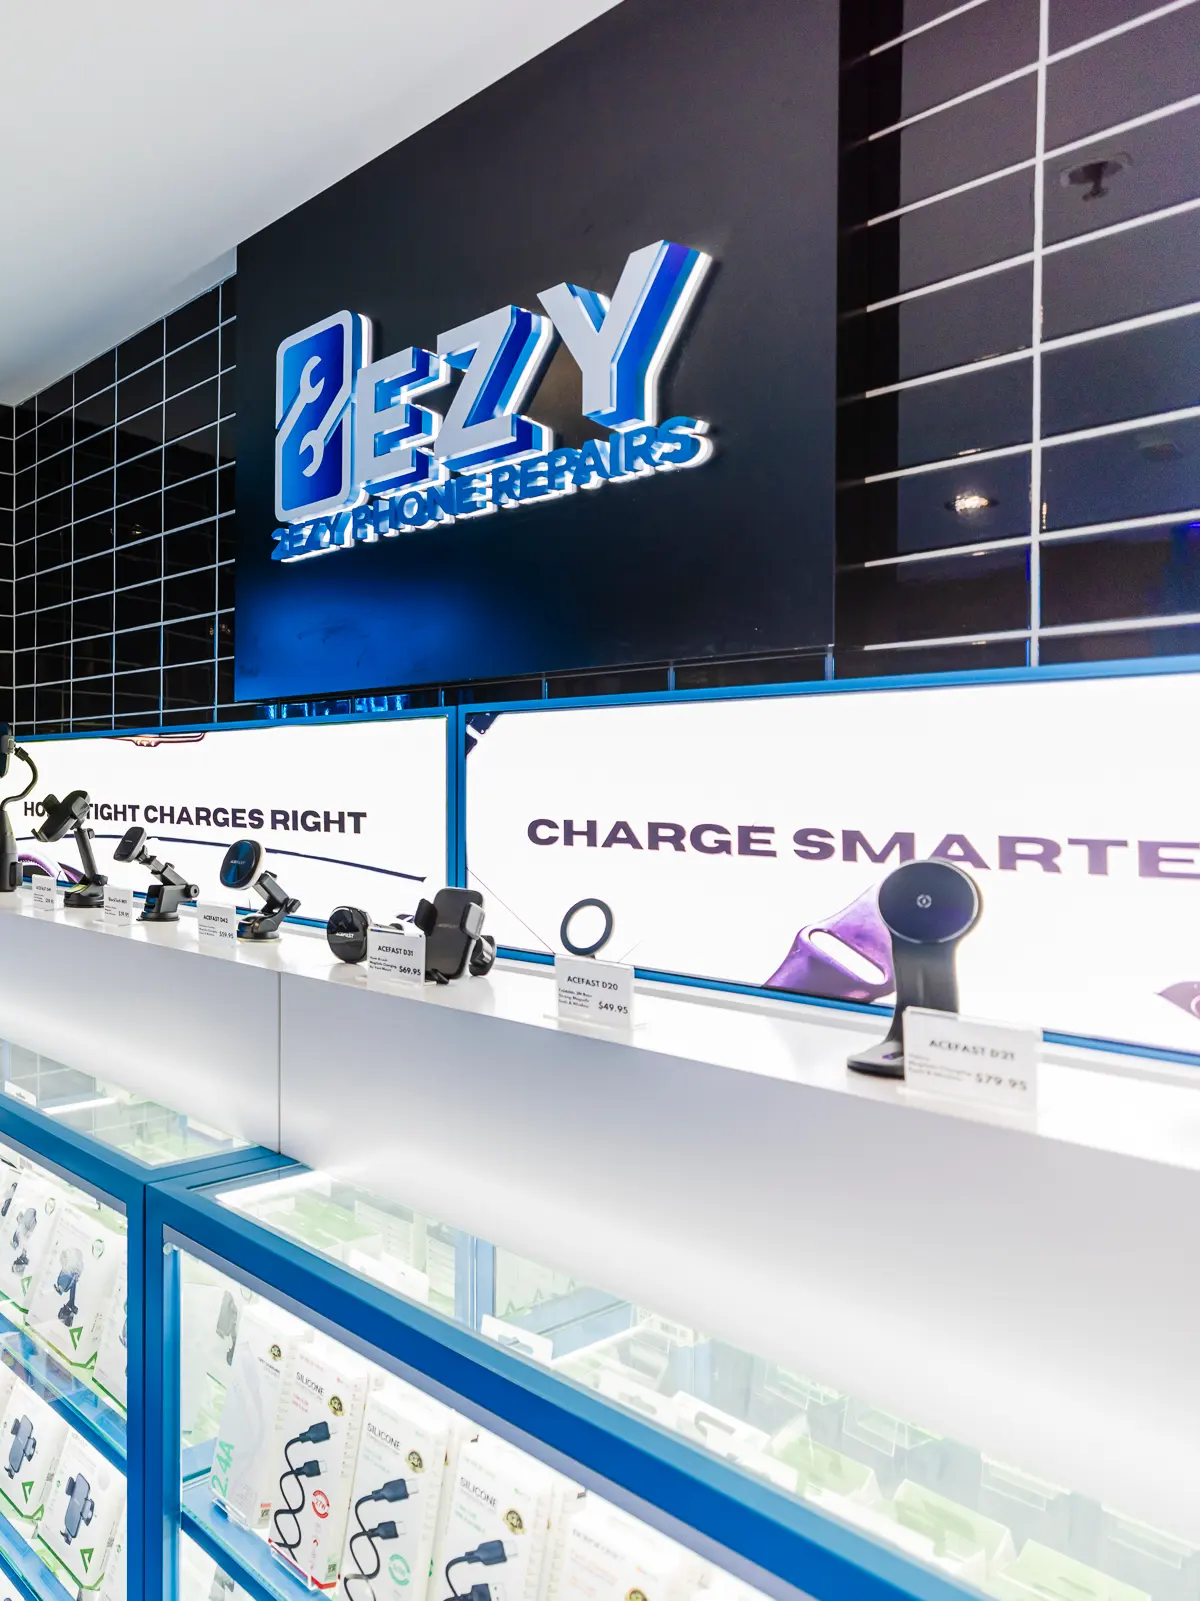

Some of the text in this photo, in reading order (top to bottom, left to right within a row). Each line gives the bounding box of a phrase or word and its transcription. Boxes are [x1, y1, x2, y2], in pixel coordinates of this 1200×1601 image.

[352, 474, 496, 542] PHONE
[492, 416, 713, 508] REPAIRS
[144, 804, 265, 830] CHARGES
[270, 808, 367, 835] RIGHT
[526, 817, 777, 858] CHARGE
[378, 945, 402, 955] ACEFAST
[399, 965, 422, 977] $69.95
[567, 975, 619, 991] ACEFAST D20
[598, 1000, 629, 1014] $49.95
[928, 1039, 1015, 1061] ACEFAST D21
[295, 1371, 325, 1397] SILICONE
[367, 1421, 402, 1451] SILICONE
[459, 1476, 498, 1508] SILICONE
